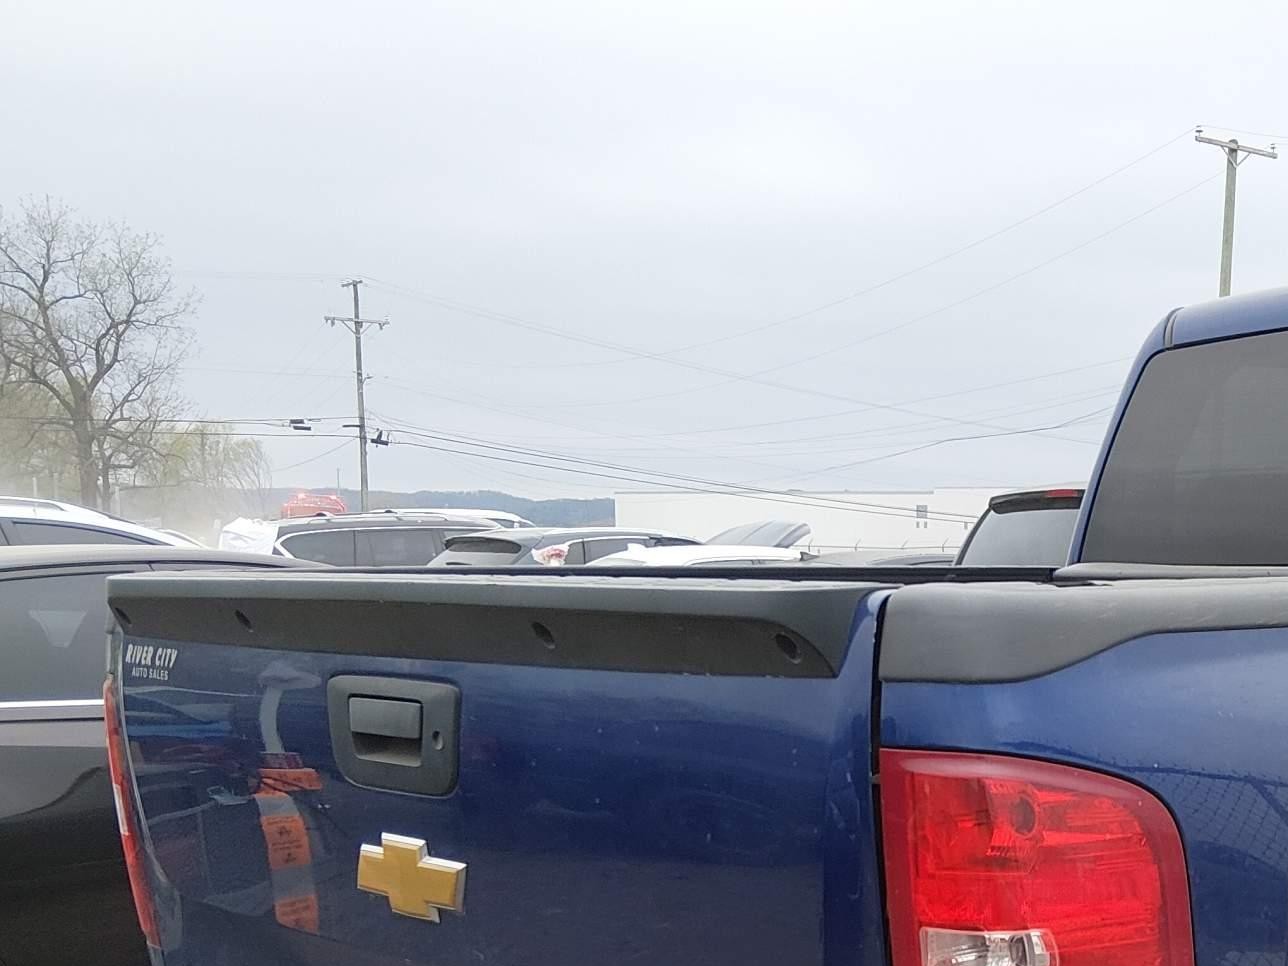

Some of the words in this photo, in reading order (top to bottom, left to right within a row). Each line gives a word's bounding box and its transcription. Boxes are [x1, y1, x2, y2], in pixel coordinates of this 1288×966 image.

[125, 643, 154, 666] RIVER
[155, 647, 178, 669] CITY
[131, 666, 148, 679] AUTO
[148, 668, 169, 681] SALES
